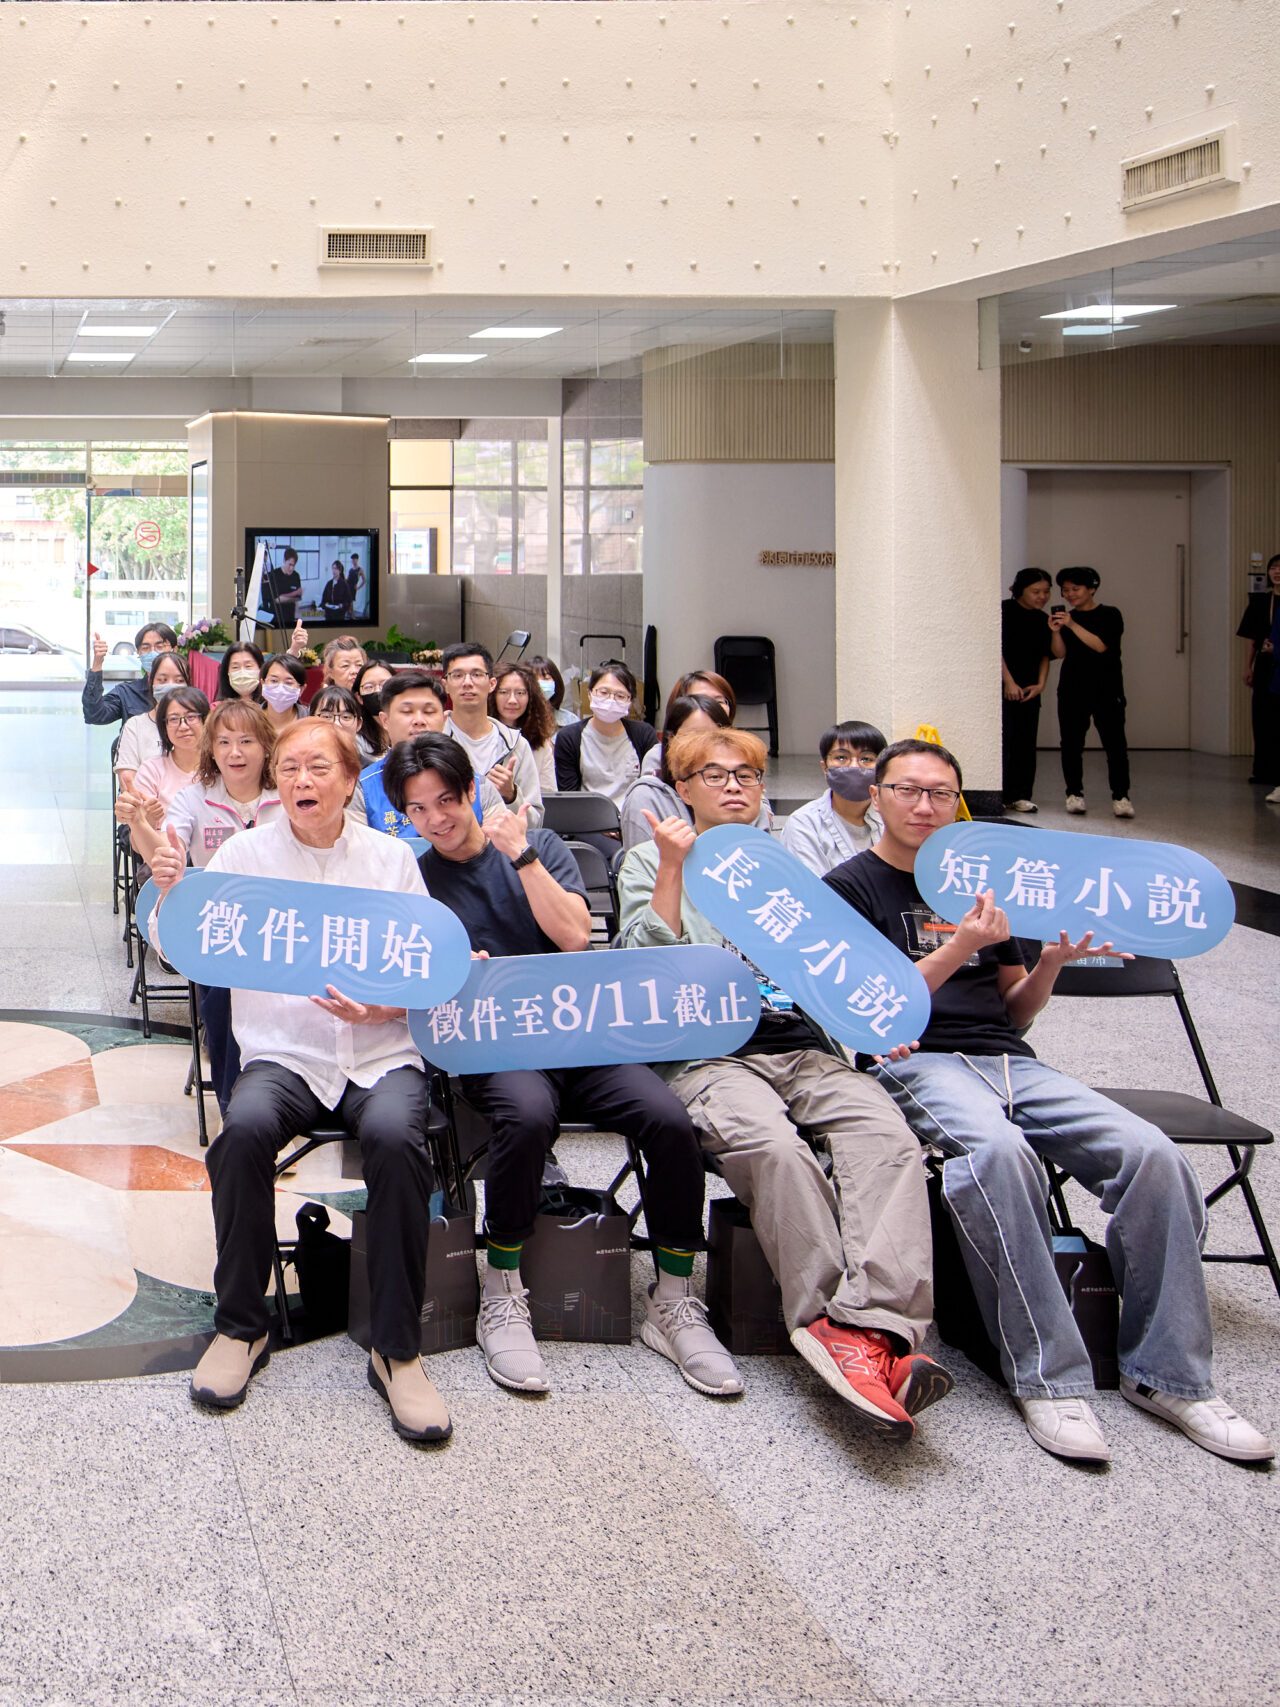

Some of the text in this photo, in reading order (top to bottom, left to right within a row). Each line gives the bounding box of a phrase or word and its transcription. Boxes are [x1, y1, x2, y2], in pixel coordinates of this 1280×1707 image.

[196, 900, 433, 980] 徵件開始
[427, 978, 753, 1045] 徵件至8/11截止
